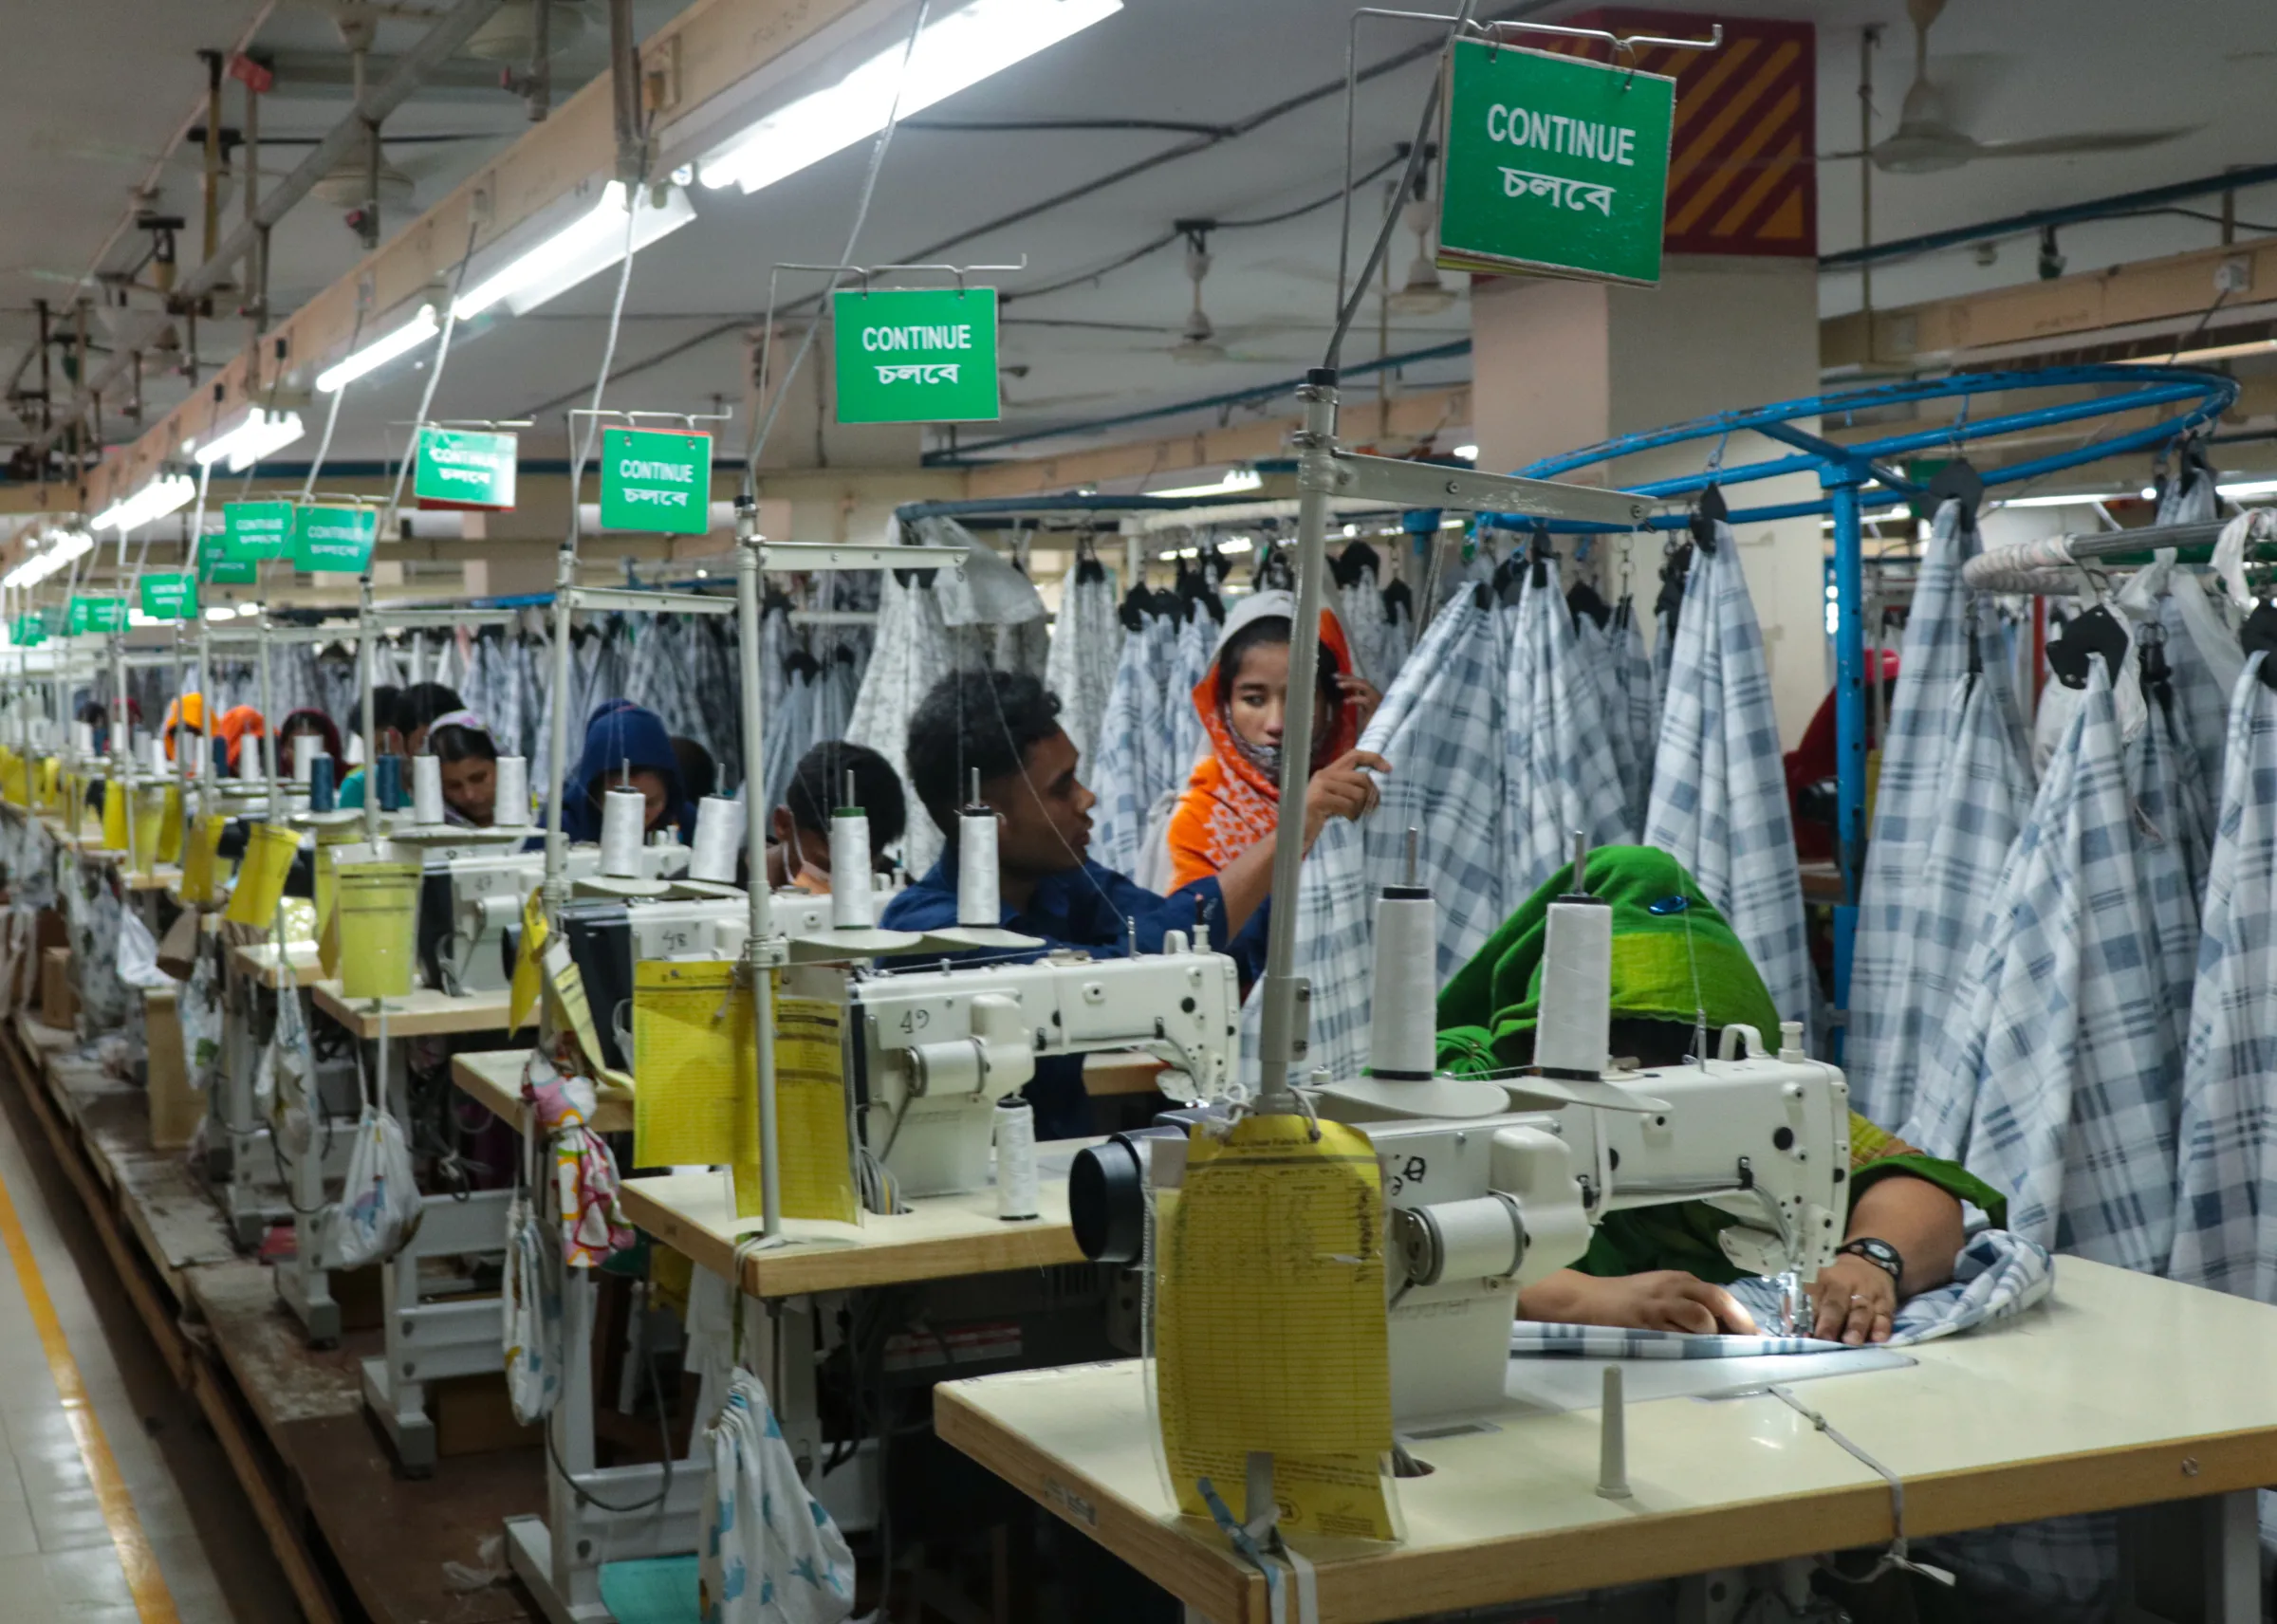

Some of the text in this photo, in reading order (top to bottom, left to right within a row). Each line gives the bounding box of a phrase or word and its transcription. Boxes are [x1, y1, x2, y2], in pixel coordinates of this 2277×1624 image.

[1487, 103, 1637, 167] CONTINUE
[1497, 166, 1617, 217] চলবে
[861, 324, 972, 352] CONTINUE
[874, 363, 961, 385] চলবে
[619, 459, 694, 484] CONTINUE
[622, 488, 690, 508] চলবে
